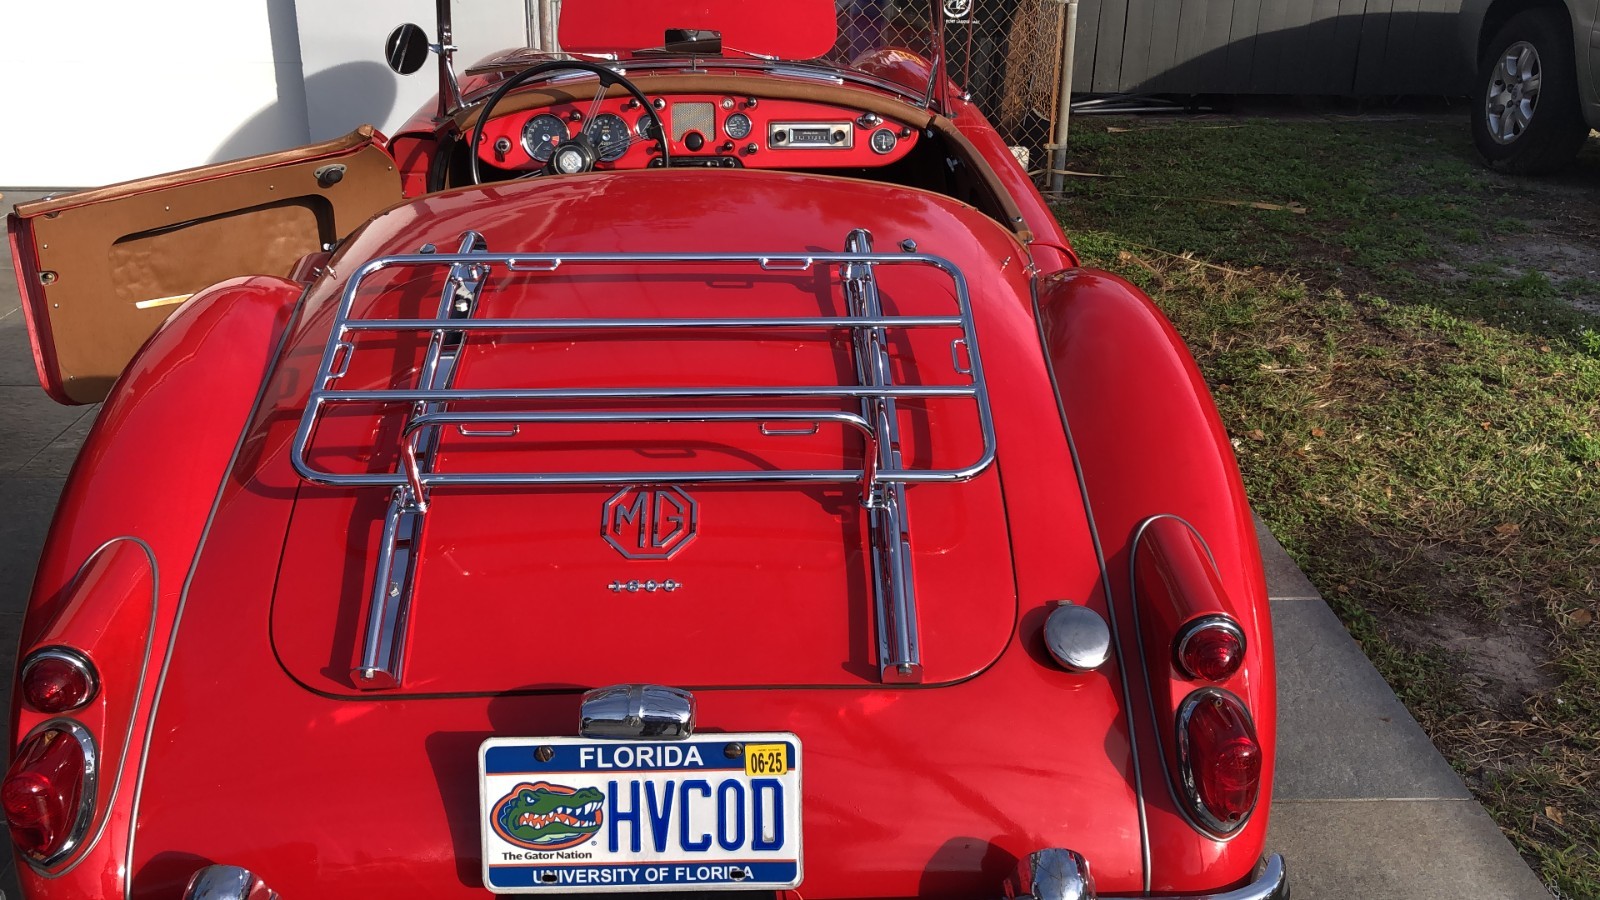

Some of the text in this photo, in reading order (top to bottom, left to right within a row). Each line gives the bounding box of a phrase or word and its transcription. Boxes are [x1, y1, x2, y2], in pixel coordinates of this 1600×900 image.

[612, 489, 686, 550] MG
[607, 579, 682, 592] 1600
[579, 745, 704, 768] FLORIDA
[751, 752, 783, 774] 06-25
[502, 850, 593, 861] The Gator Nation
[644, 867, 669, 882] OF
